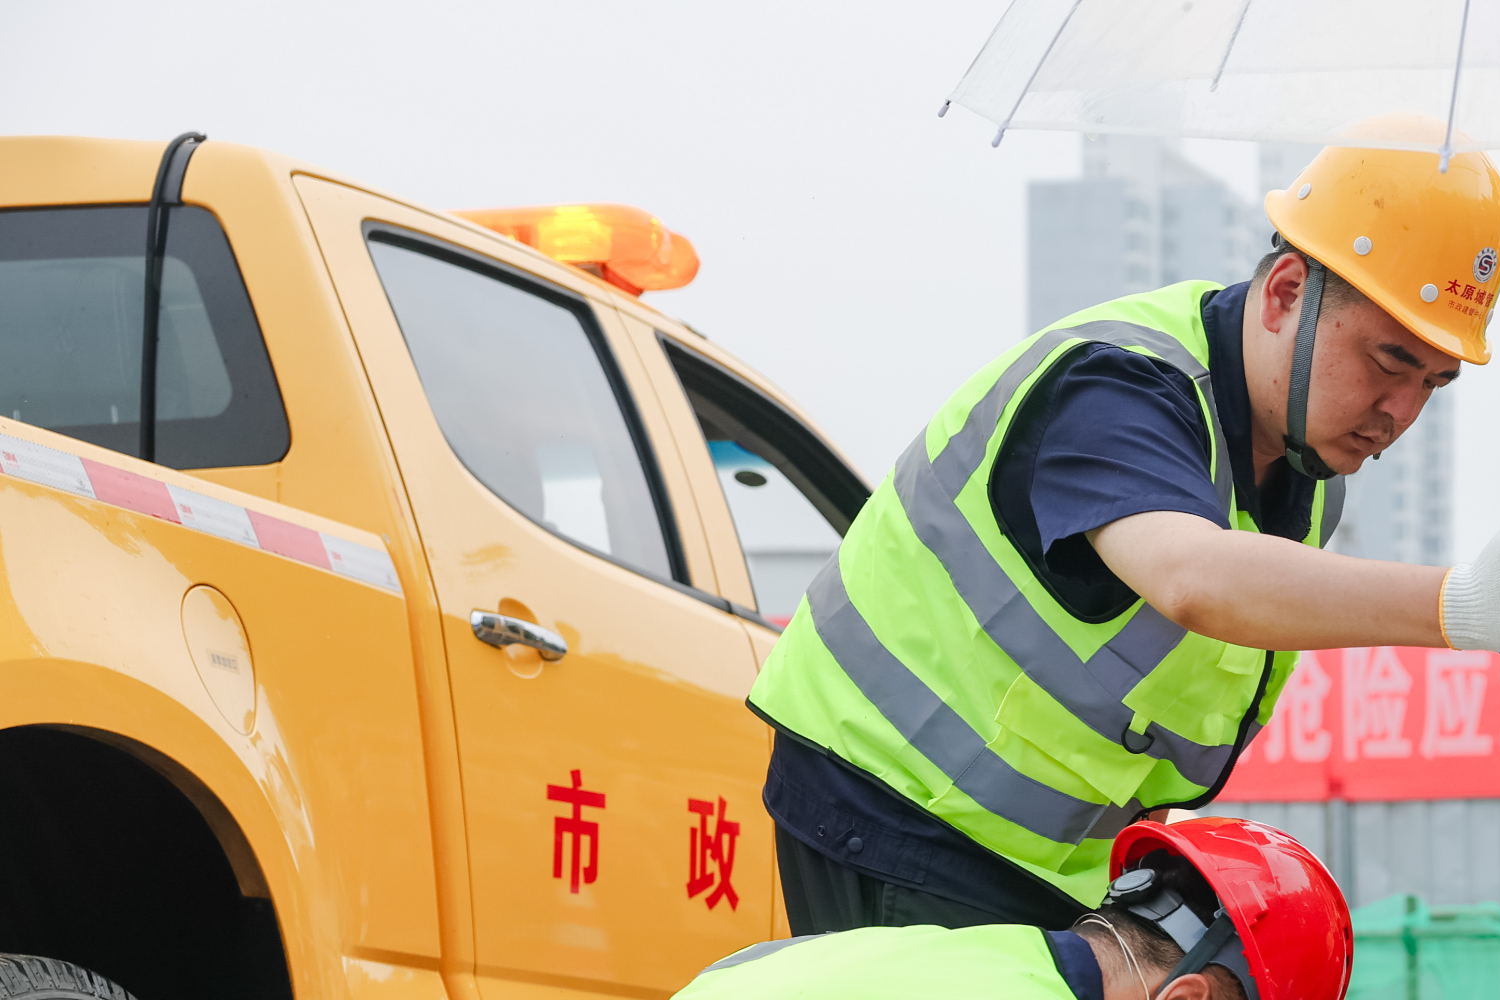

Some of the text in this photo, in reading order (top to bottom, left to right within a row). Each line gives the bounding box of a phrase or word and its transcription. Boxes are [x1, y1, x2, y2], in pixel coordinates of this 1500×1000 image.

[1444, 279, 1495, 308] 太原城管
[547, 769, 740, 914] 市政
